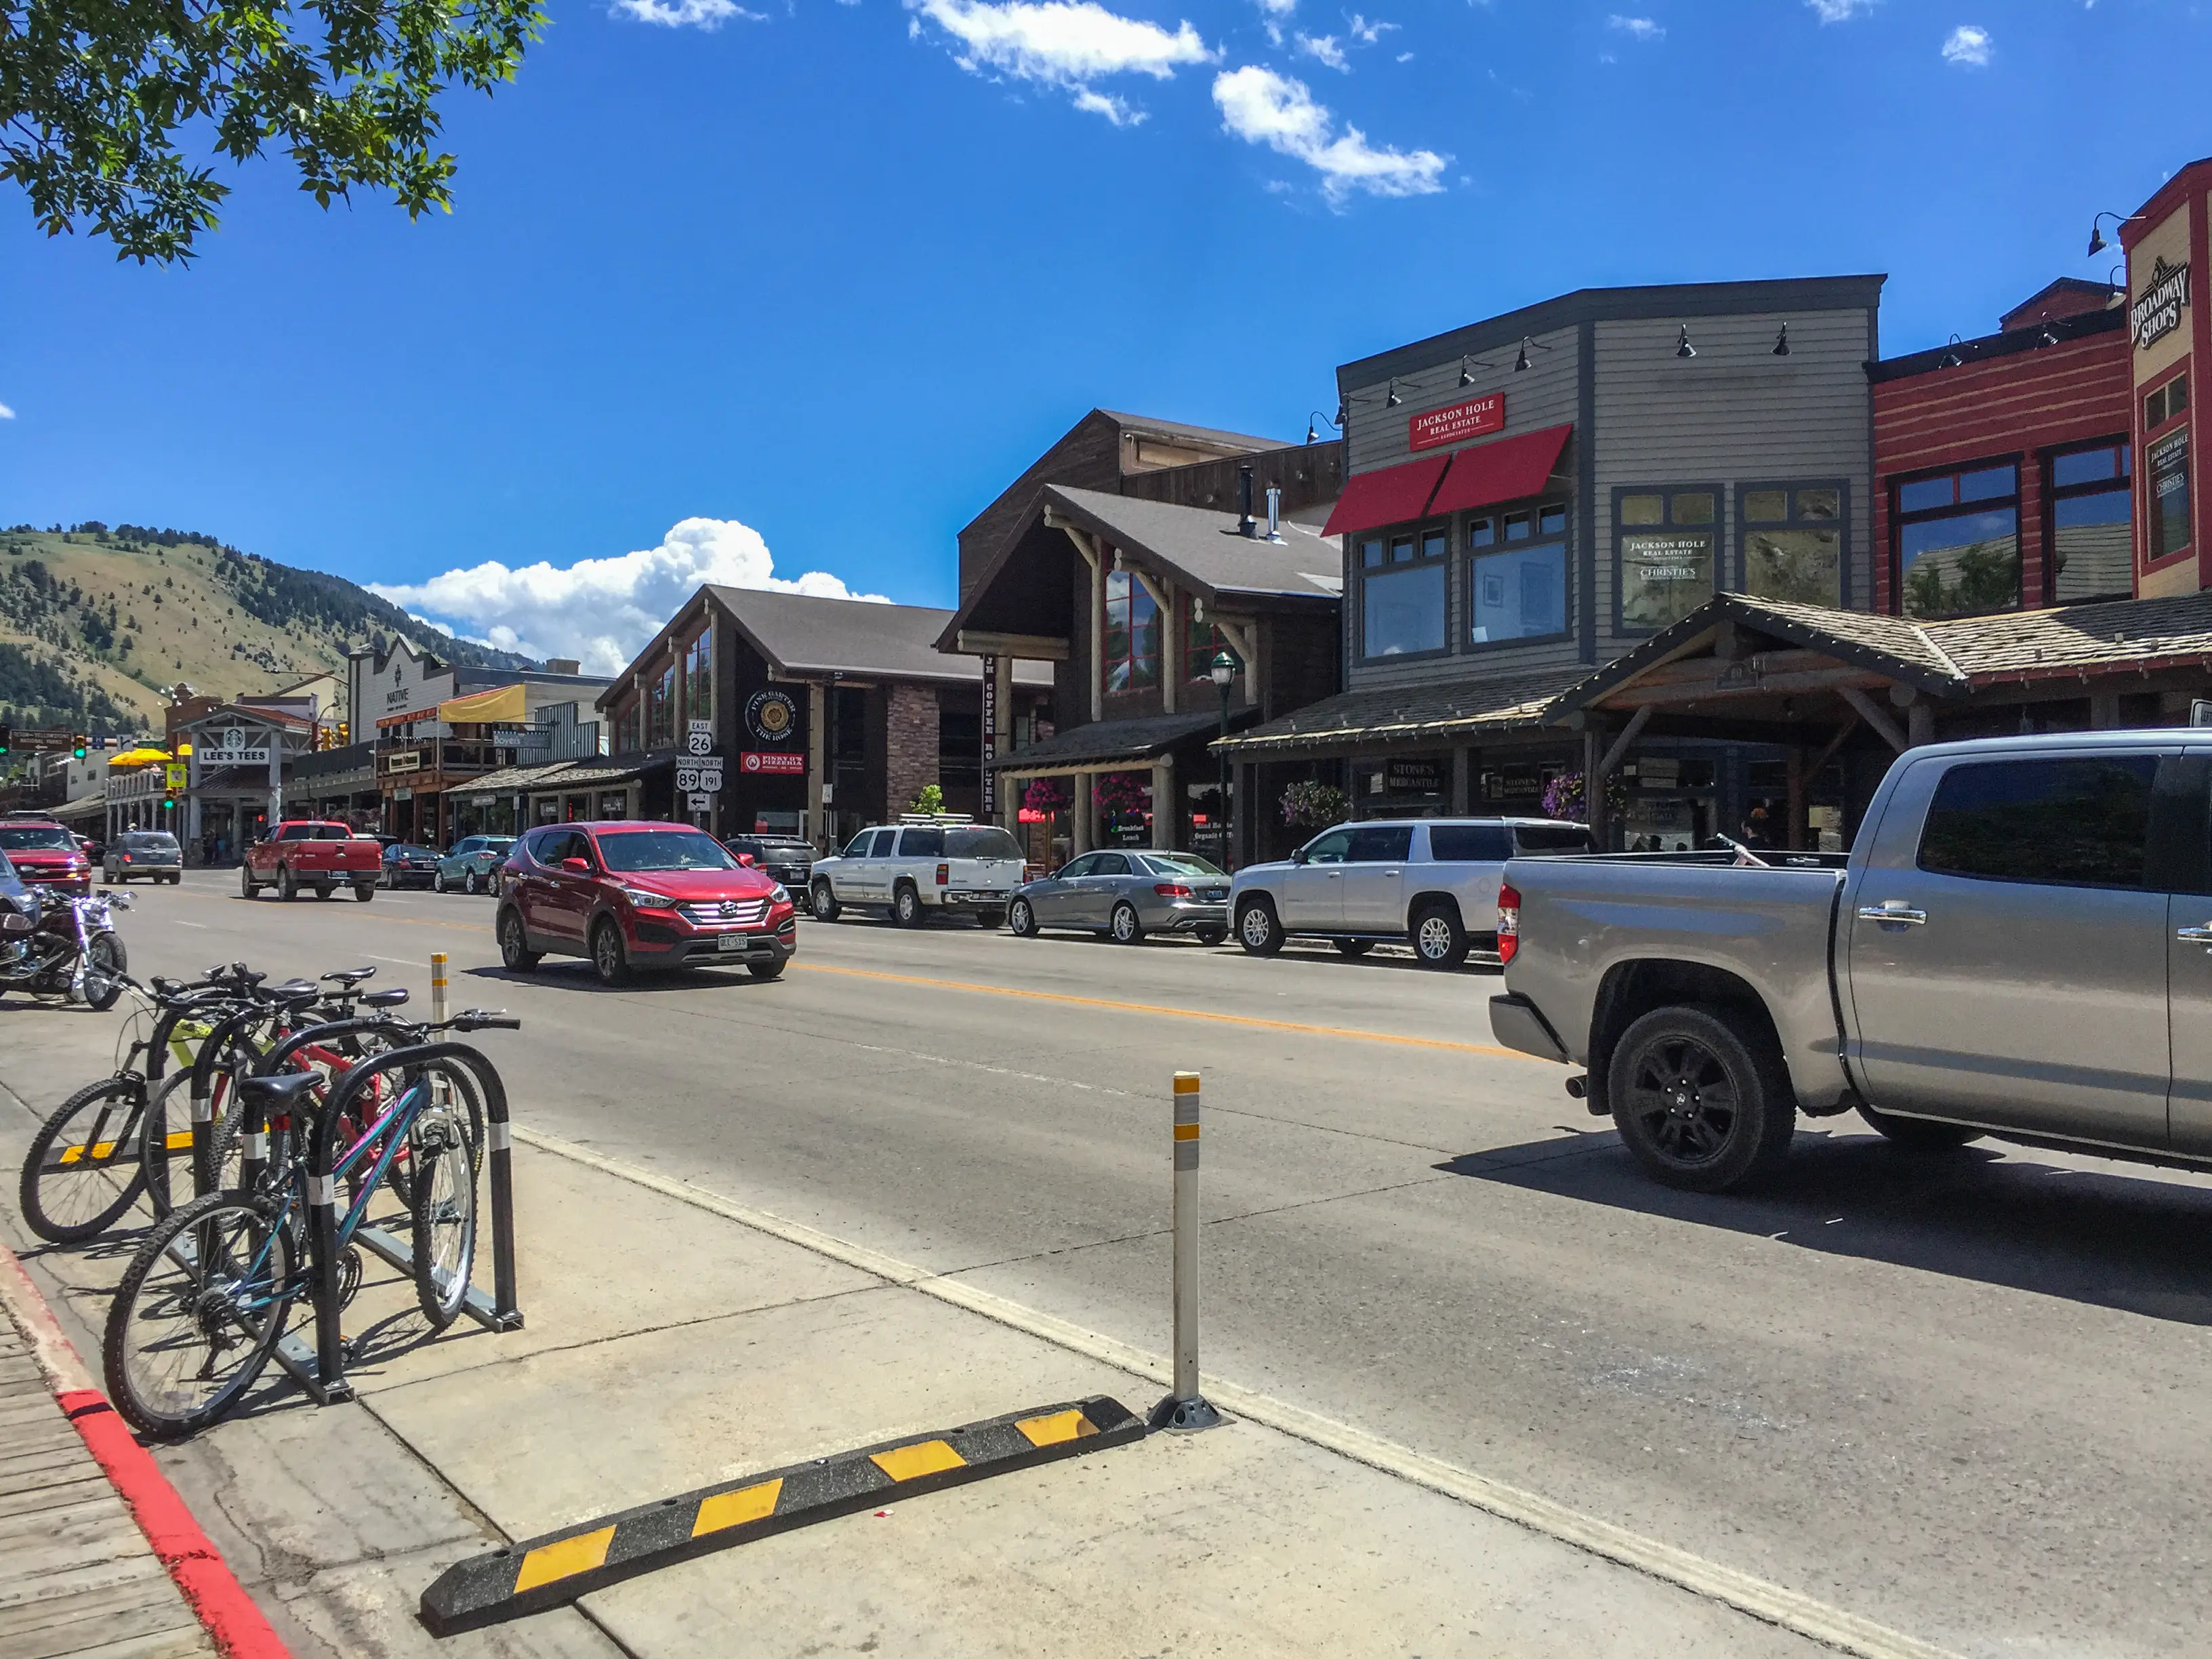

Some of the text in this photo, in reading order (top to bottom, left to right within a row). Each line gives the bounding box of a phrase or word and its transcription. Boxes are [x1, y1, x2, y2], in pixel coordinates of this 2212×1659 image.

[2131, 268, 2187, 344] BROADWAY
[2142, 301, 2177, 348] SHOPS
[1416, 400, 1494, 431] JACKSON HOLE
[1430, 415, 1481, 435] REAL ESTATE
[2151, 434, 2188, 464] JACKSON HOLE
[1630, 540, 1706, 551] JACKSON HOLE
[386, 688, 409, 705] NATIVE
[752, 692, 767, 710] PINK
[985, 683, 994, 734] COFFEE
[691, 737, 709, 750] 26
[204, 752, 265, 760] LEE'S TEES
[679, 774, 697, 786] 89
[705, 777, 717, 786] 191
